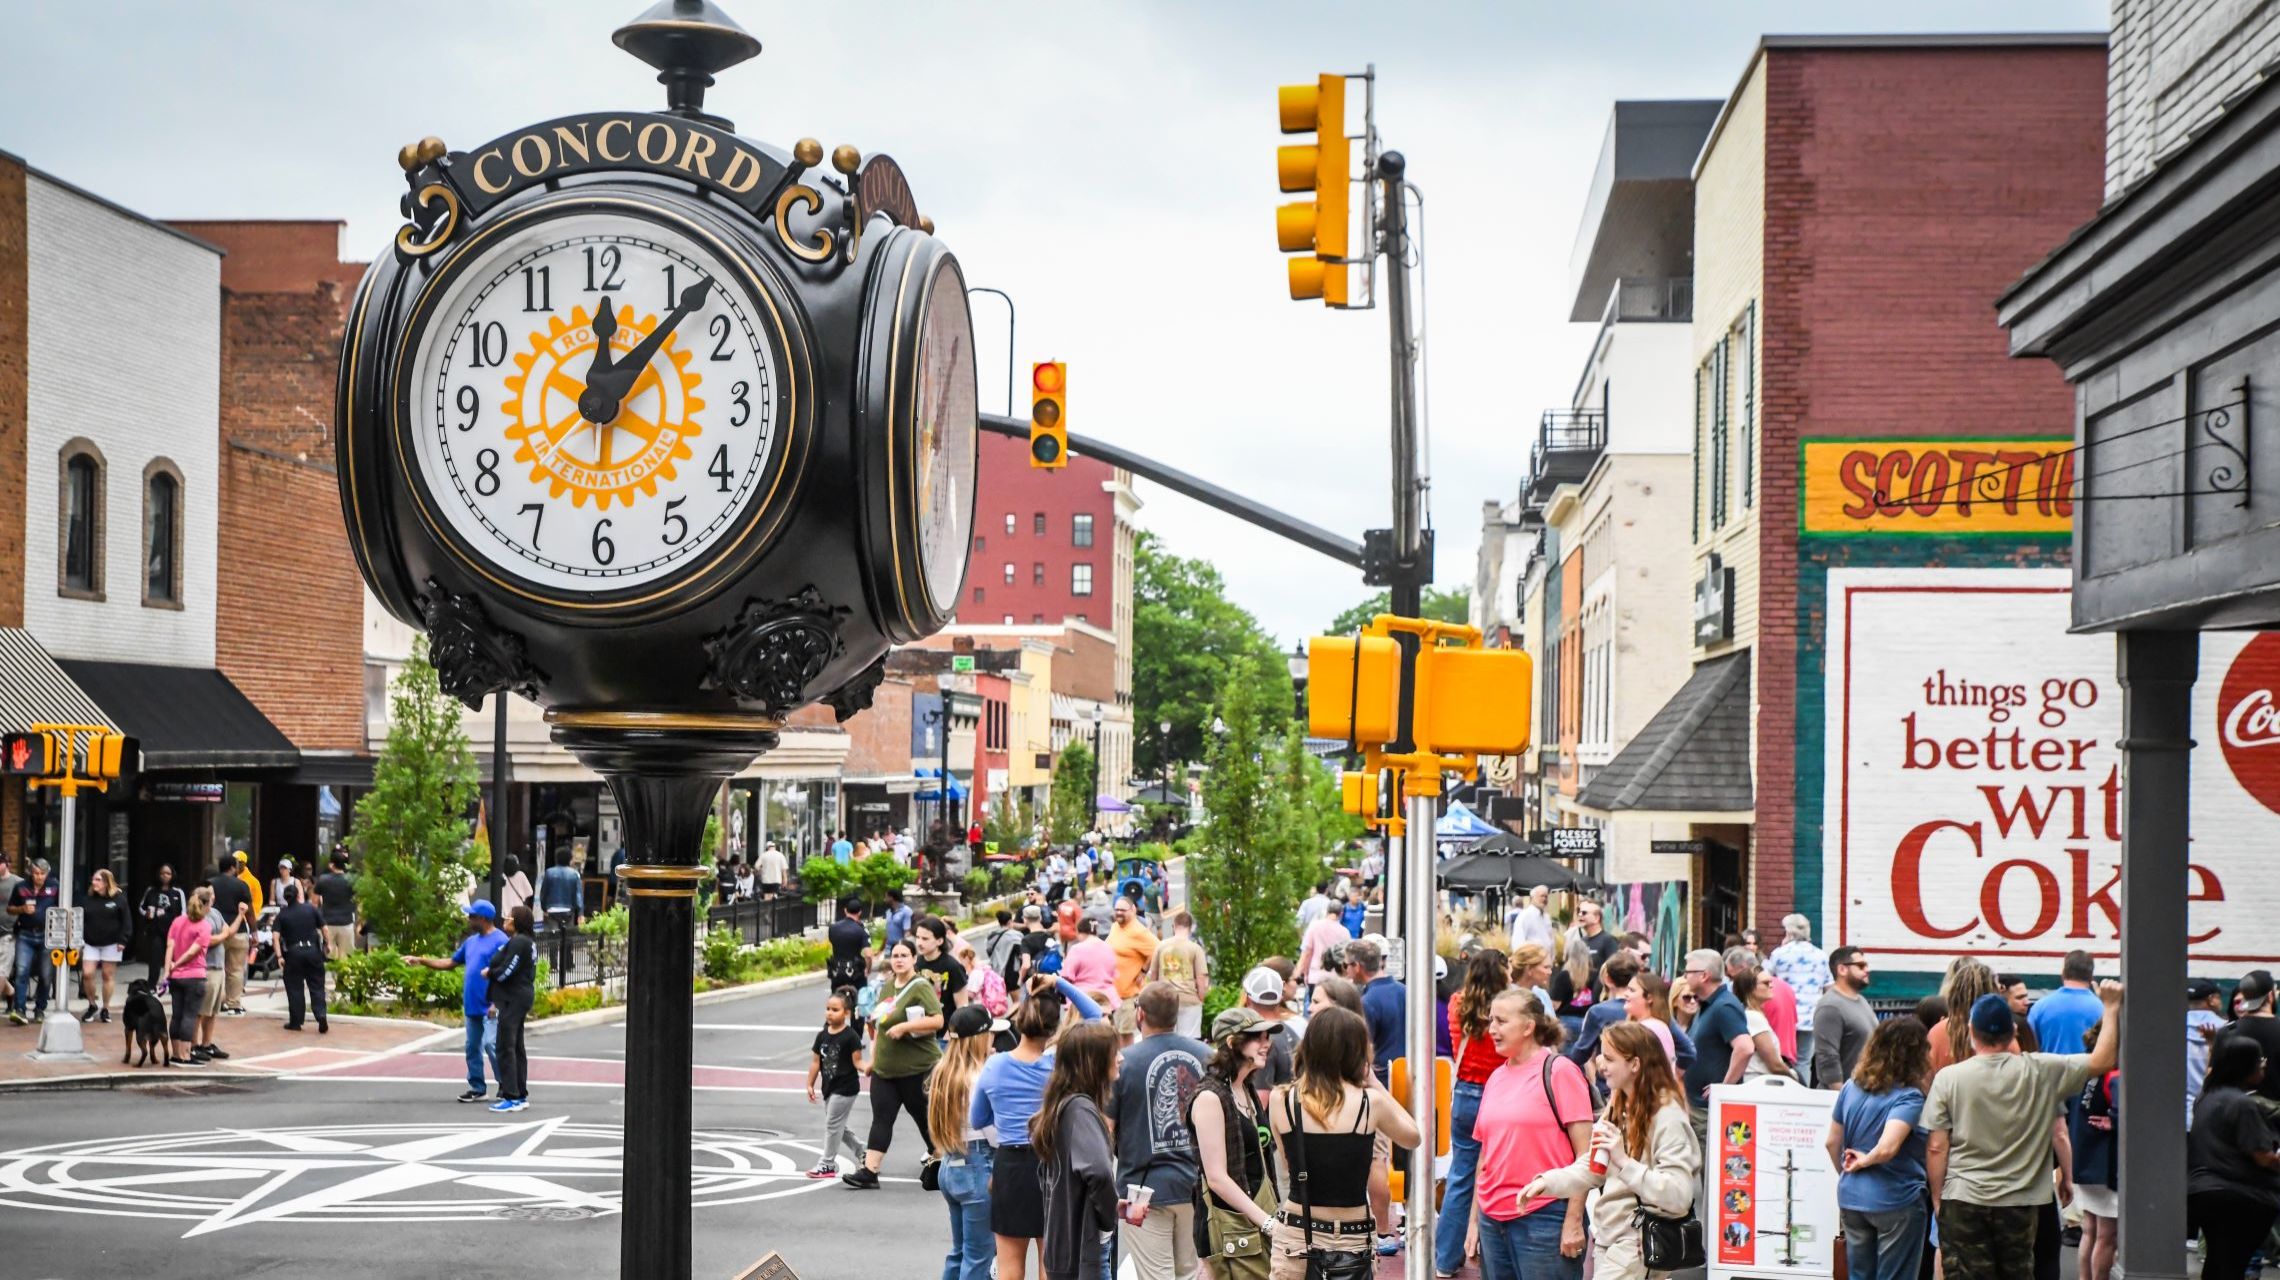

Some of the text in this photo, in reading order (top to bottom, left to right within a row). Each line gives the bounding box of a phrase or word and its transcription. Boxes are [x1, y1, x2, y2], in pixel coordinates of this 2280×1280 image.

[473, 118, 762, 195] CONCORD
[520, 265, 554, 312] 11
[582, 245, 626, 292] 12
[661, 264, 680, 311] 1
[468, 320, 508, 368] 10
[708, 313, 736, 361] 2
[456, 384, 480, 432] 9
[729, 380, 751, 427] 3
[474, 448, 501, 496] 8
[707, 443, 734, 493] 4
[516, 502, 545, 551] 7
[592, 518, 615, 566] 6
[661, 494, 688, 545] 5
[1922, 669, 2098, 728] things go
[1900, 710, 2097, 772] better
[1976, 762, 2194, 841] wit
[1553, 838, 1598, 849] PORTER
[1793, 1127, 1816, 1135] STREET
